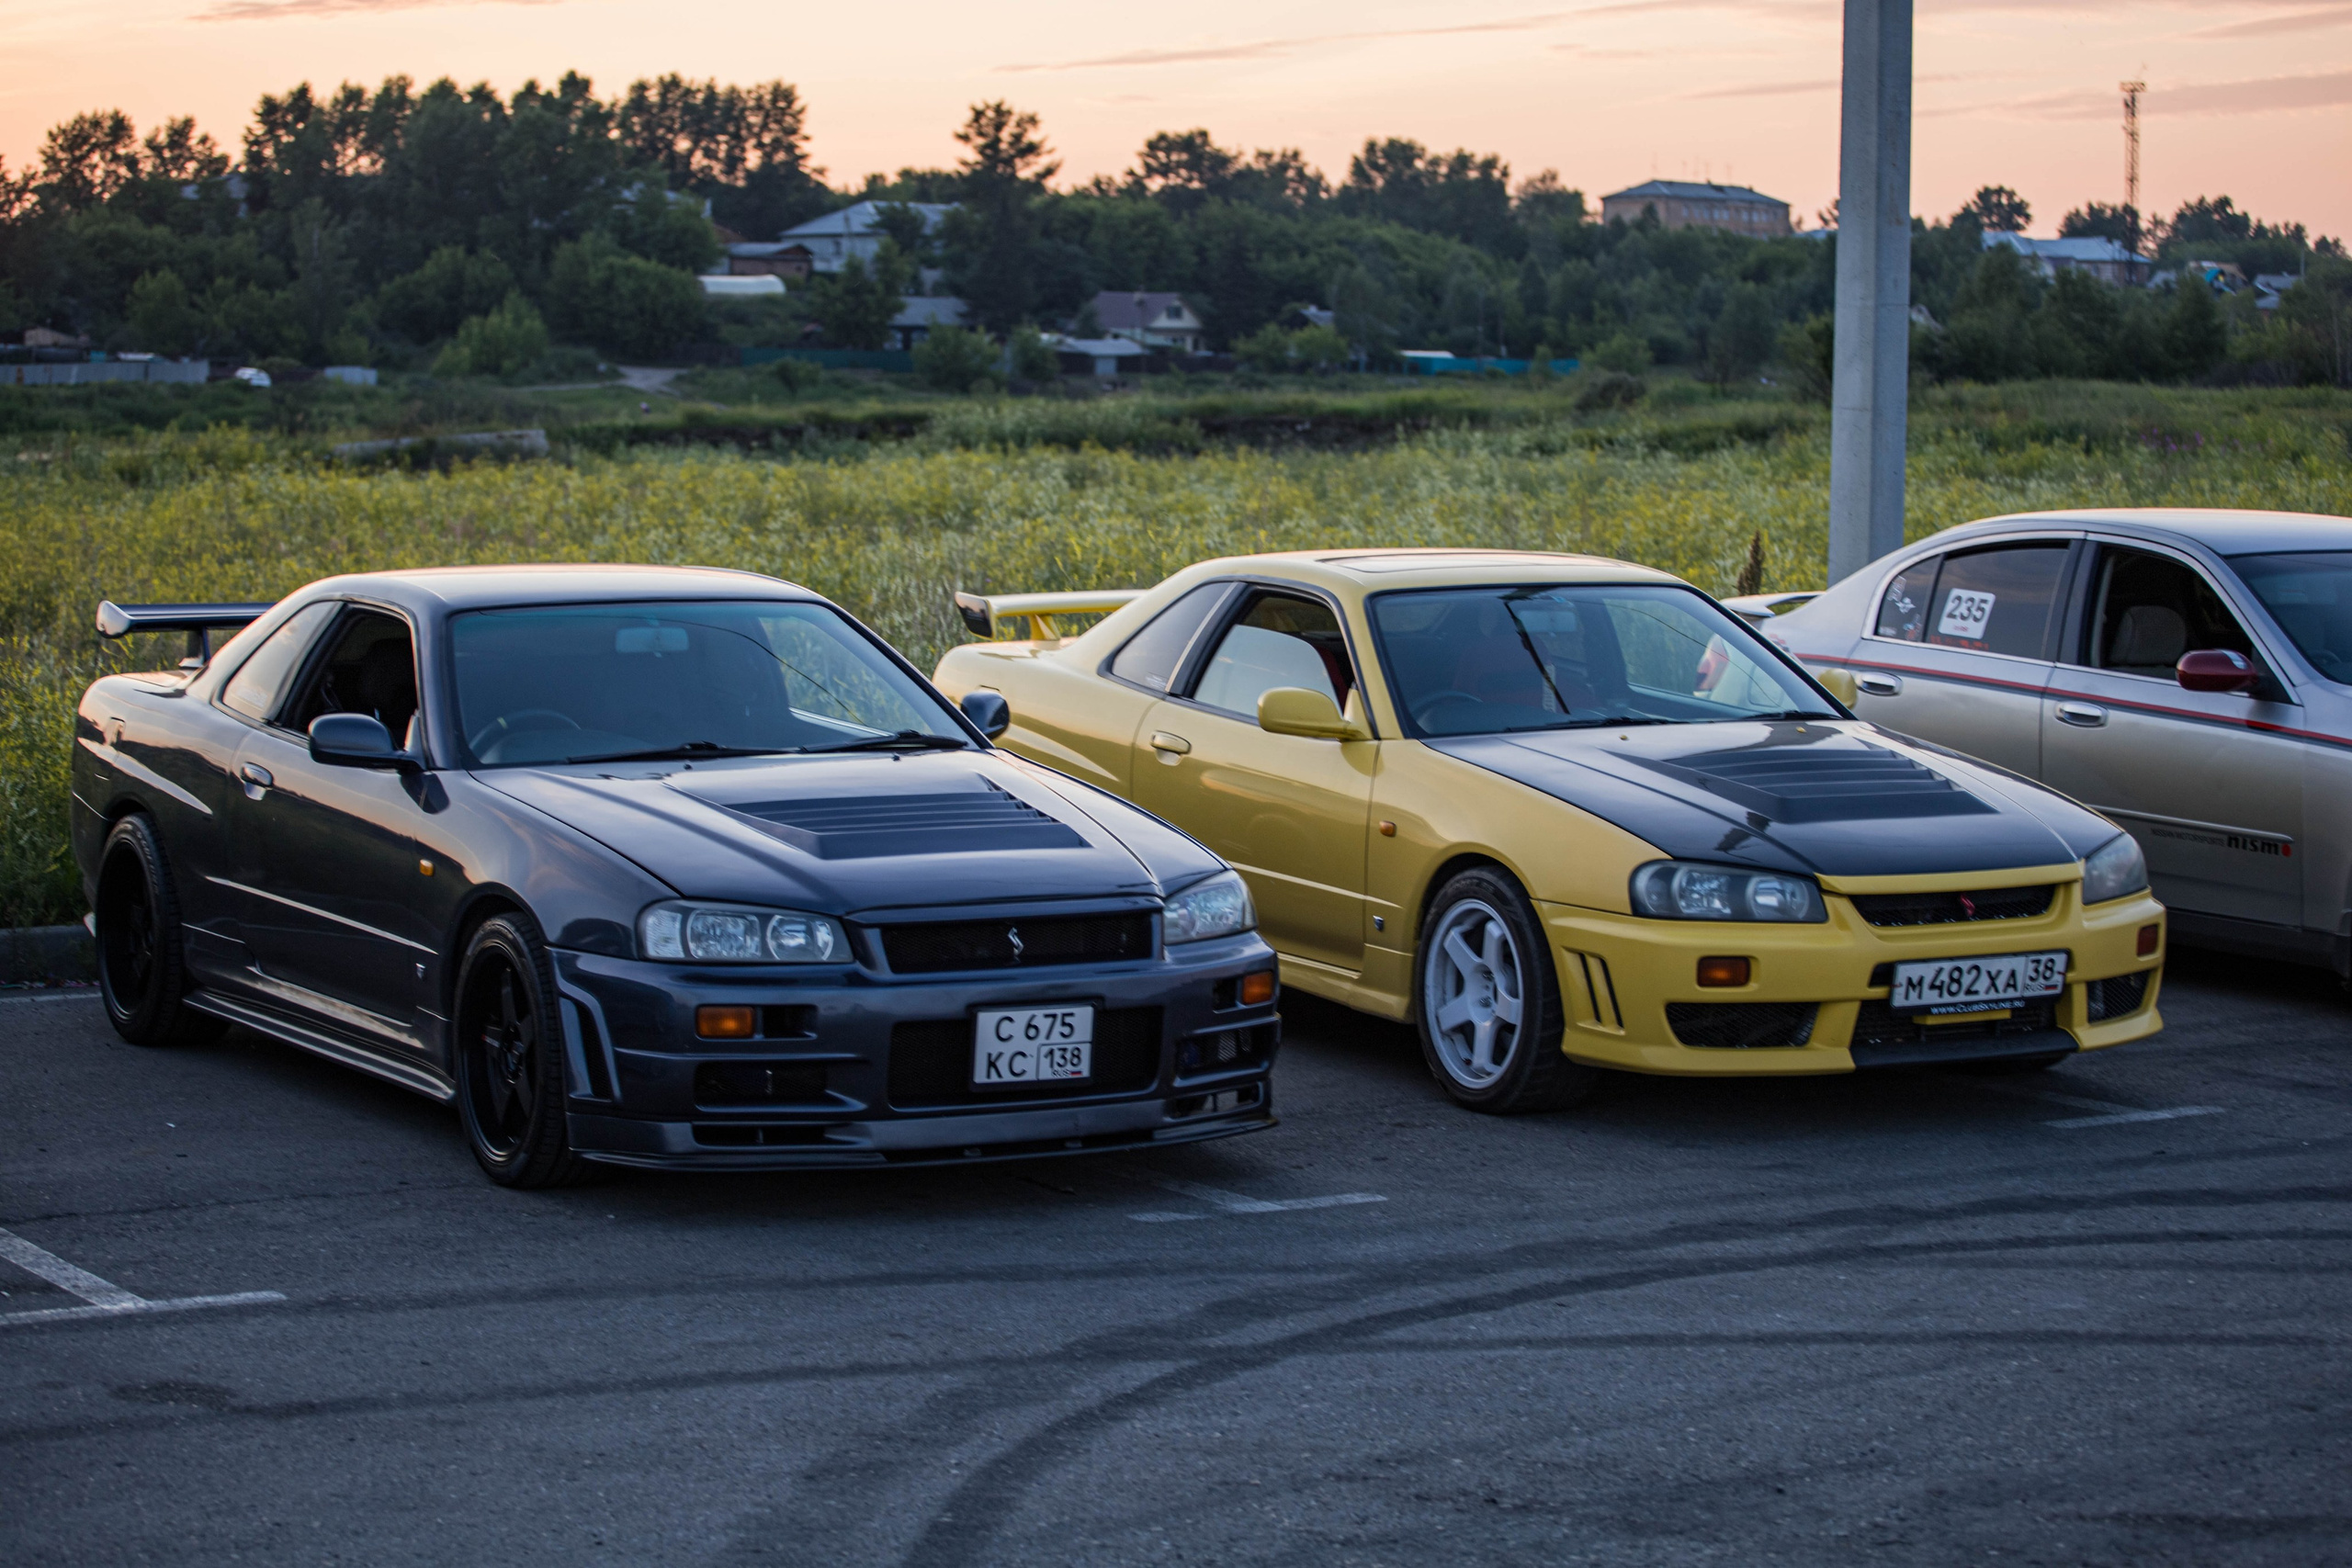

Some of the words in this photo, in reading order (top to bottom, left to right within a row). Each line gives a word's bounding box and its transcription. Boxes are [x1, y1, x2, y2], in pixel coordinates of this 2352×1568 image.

[1946, 595, 1989, 623] 235
[2027, 957, 2056, 982] 38
[2024, 982, 2044, 993] RUS
[1024, 1011, 1076, 1041] 675
[1043, 1046, 1082, 1069] 138
[1052, 1067, 1070, 1077] RUS
